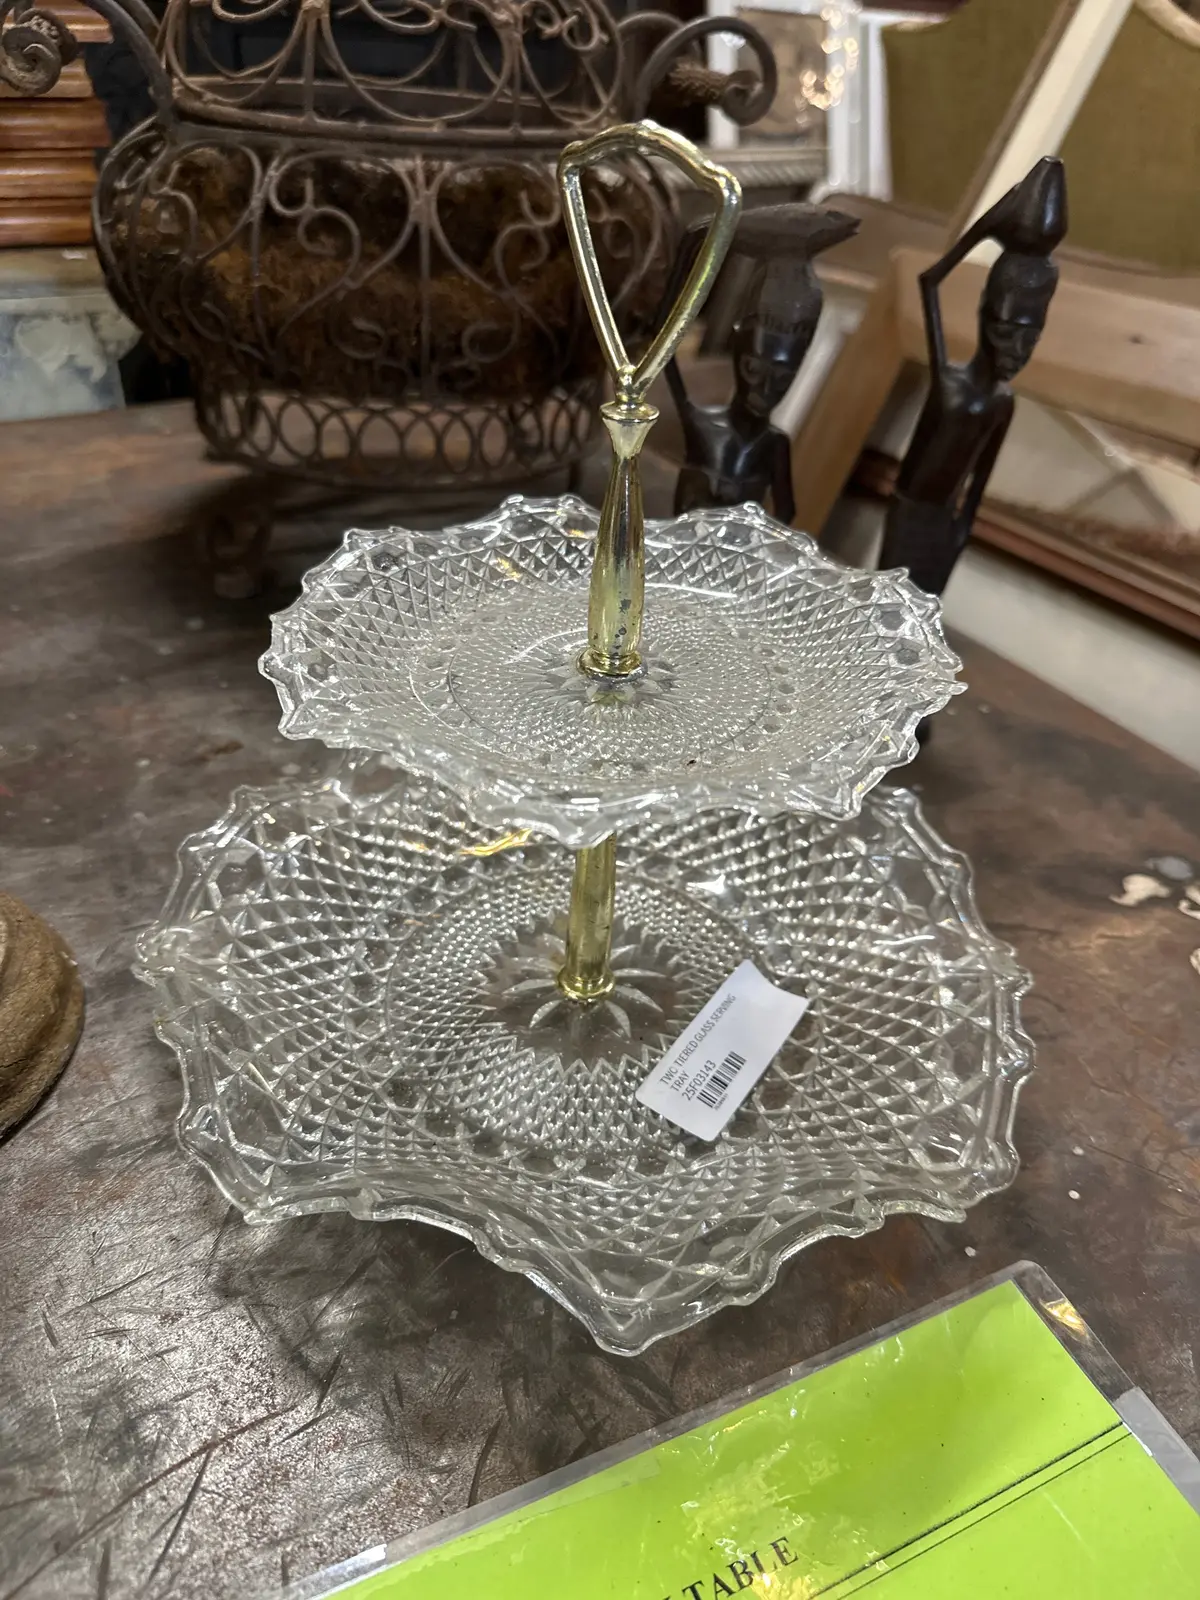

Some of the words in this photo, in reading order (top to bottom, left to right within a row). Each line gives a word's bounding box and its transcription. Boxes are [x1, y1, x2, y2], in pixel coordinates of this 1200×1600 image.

[659, 1065, 679, 1085] TWO
[674, 1039, 699, 1067] TIERED
[694, 1019, 716, 1042] GLASS
[710, 993, 737, 1022] SERVING
[670, 1070, 690, 1092] TRAY
[681, 1059, 717, 1101] 25F03143
[682, 1536, 799, 1600] TABLE
